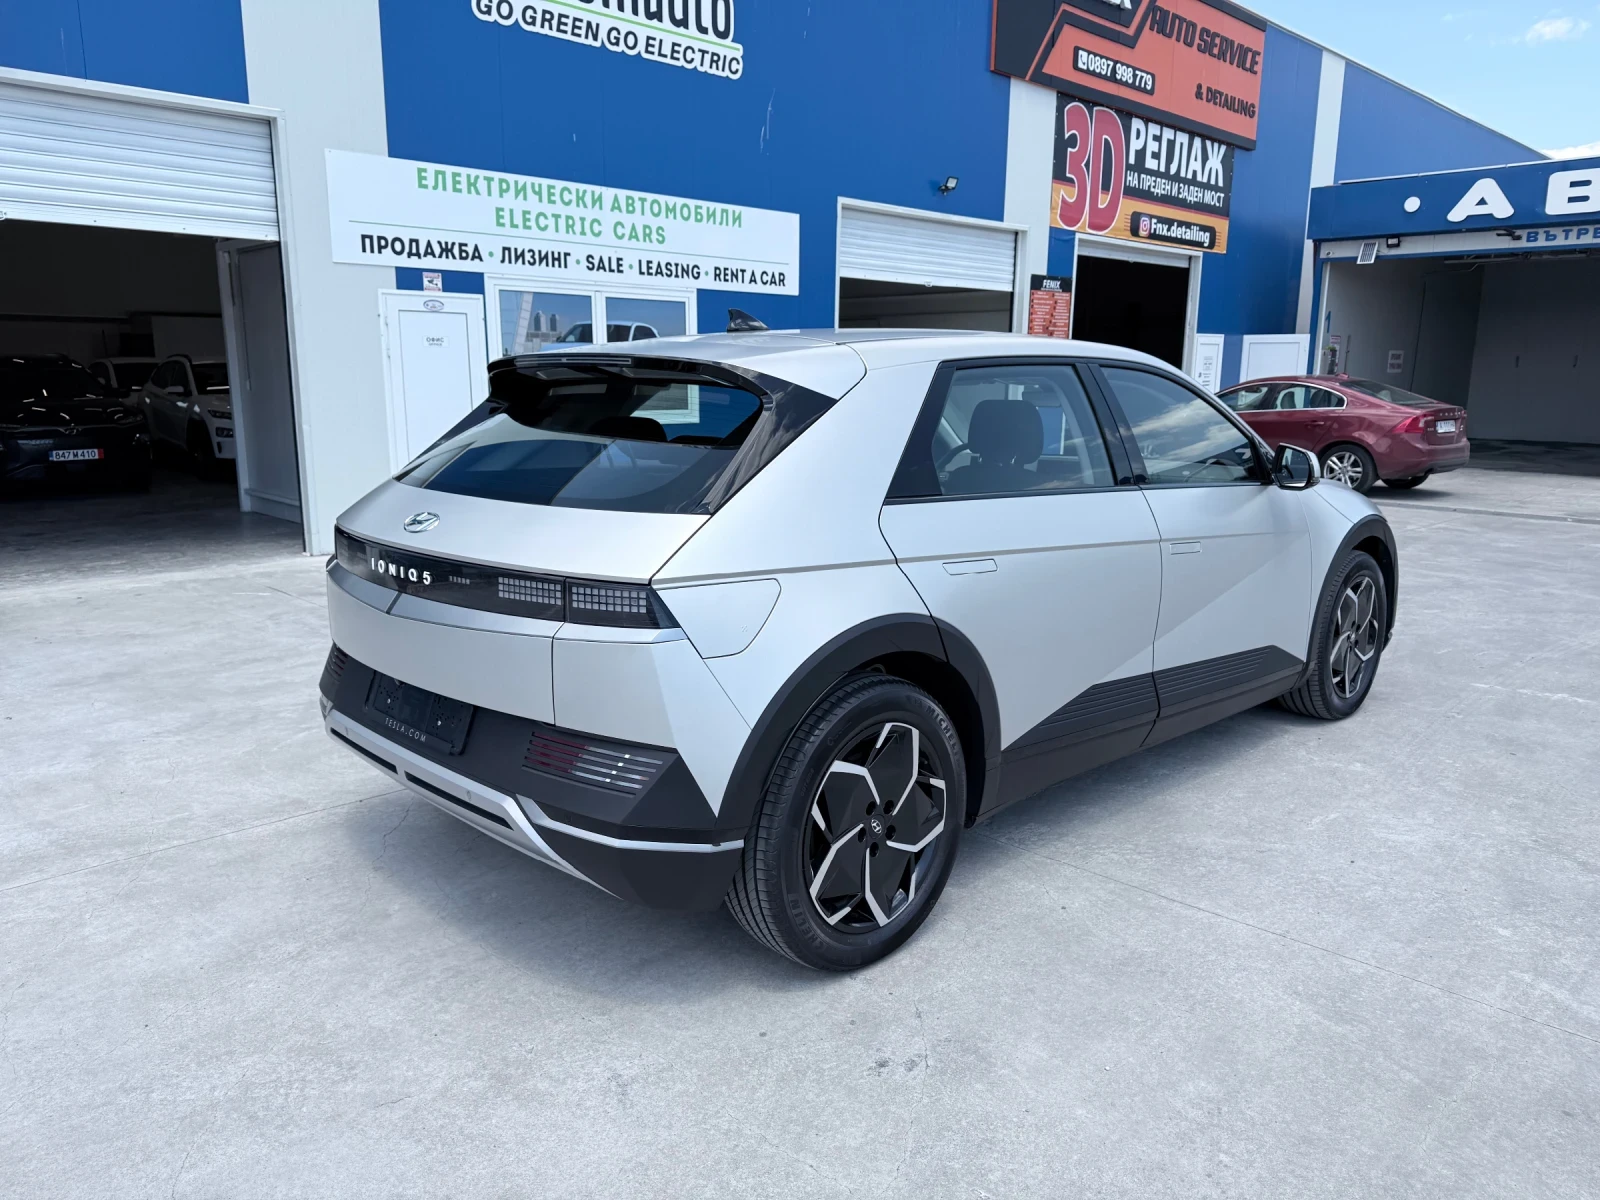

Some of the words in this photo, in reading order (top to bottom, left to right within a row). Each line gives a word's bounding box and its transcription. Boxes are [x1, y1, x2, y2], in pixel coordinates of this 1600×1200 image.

[476, 0, 513, 20] GO
[521, 5, 600, 42] GREEN
[606, 27, 639, 50] GO
[644, 35, 741, 75] ELECTRIC
[1149, 4, 1198, 47] AUTO
[1197, 26, 1261, 75] SERVICE
[1088, 54, 1114, 76] 0897
[1115, 63, 1134, 84] 998
[1135, 70, 1153, 90] 779
[1195, 83, 1203, 100] &
[1205, 86, 1256, 119] DETAILING
[1057, 102, 1126, 235] 3D
[1128, 117, 1226, 187] РЕГЛАЖ
[416, 167, 603, 211] ЕЛЕКТРИЧЕСКИ
[610, 193, 743, 228] АВТОМОБИЛИ
[1126, 170, 1138, 188] НА
[1139, 173, 1171, 197] ПРЕДЕН
[1172, 182, 1178, 197] И
[1179, 184, 1203, 204] ЗАДЕН
[1203, 189, 1225, 207] МОСТ
[495, 207, 602, 237] ELECTRIC
[613, 221, 666, 245] CARS
[1151, 218, 1210, 246] Fnx.detailing
[360, 234, 484, 262] ПРОДАЖБА
[500, 246, 571, 269] ЛИЗИНГ
[586, 254, 624, 274] SALE
[638, 259, 701, 280] LEASING
[714, 266, 747, 284] RENT
[748, 269, 758, 285] A
[760, 270, 786, 287] CAR
[1042, 279, 1061, 289] FENIX
